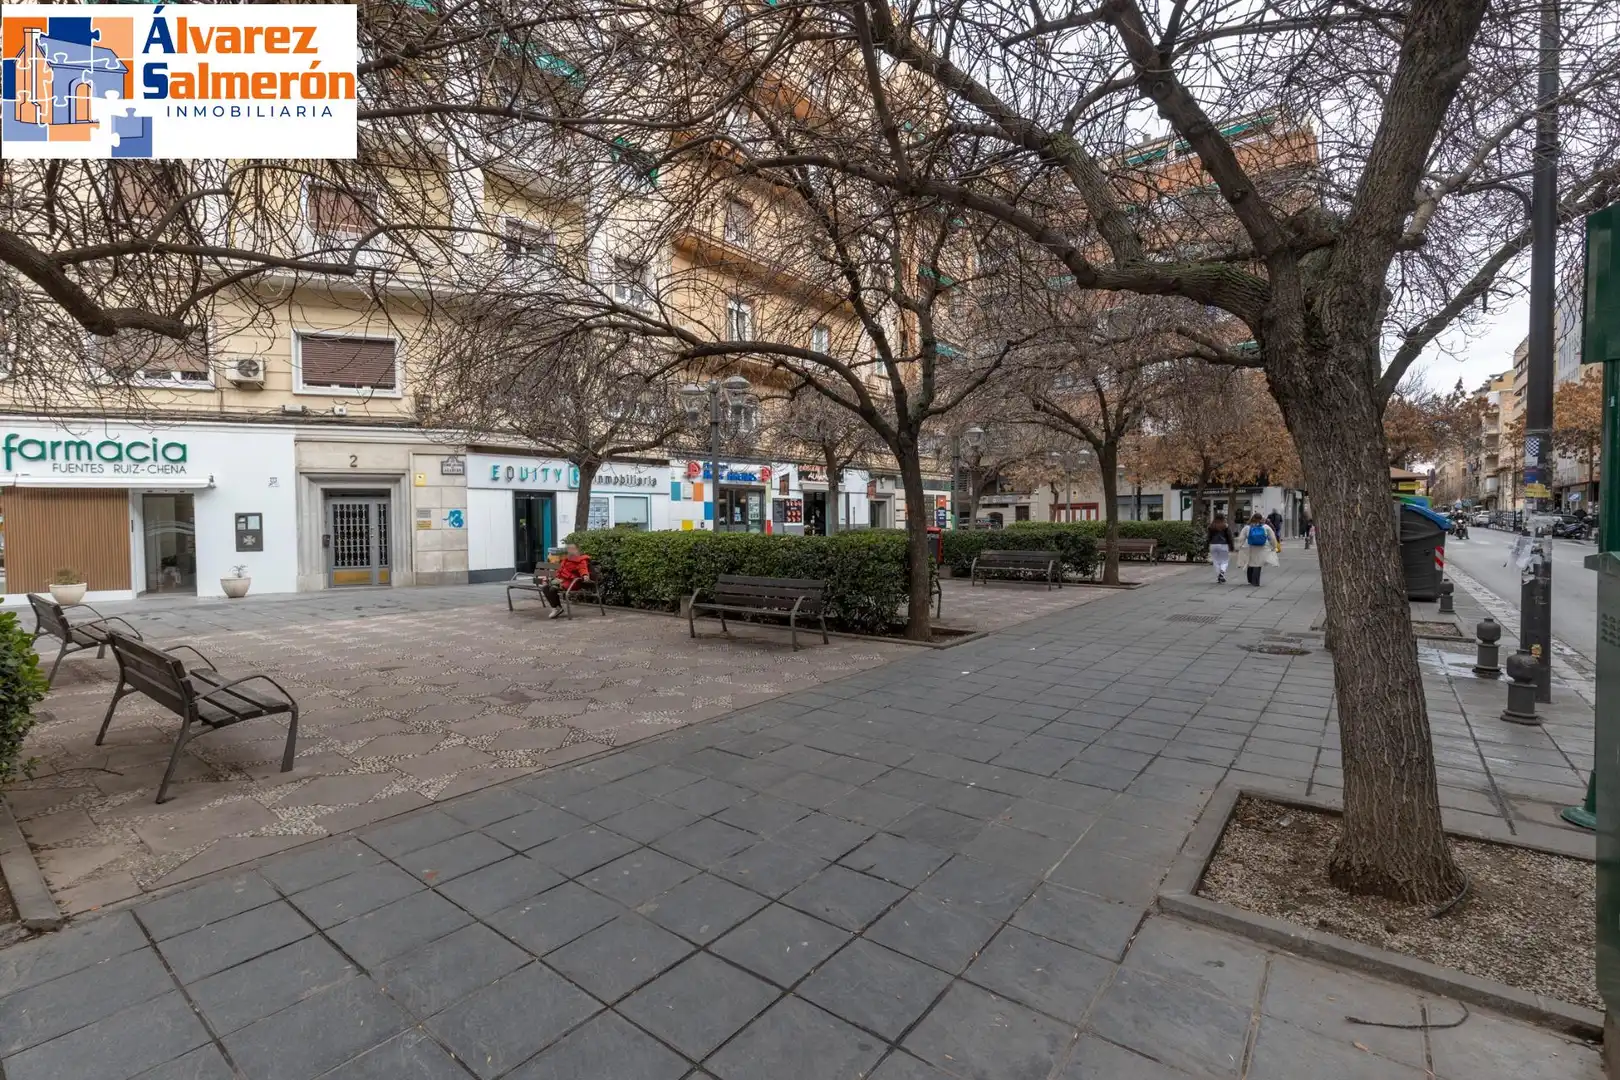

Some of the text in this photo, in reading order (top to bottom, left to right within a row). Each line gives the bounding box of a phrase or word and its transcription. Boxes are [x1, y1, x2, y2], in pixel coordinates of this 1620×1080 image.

[2, 433, 187, 471] farmacia
[52, 462, 104, 474] FUENTES
[350, 455, 358, 467] 2
[490, 464, 562, 483] EQUITY
